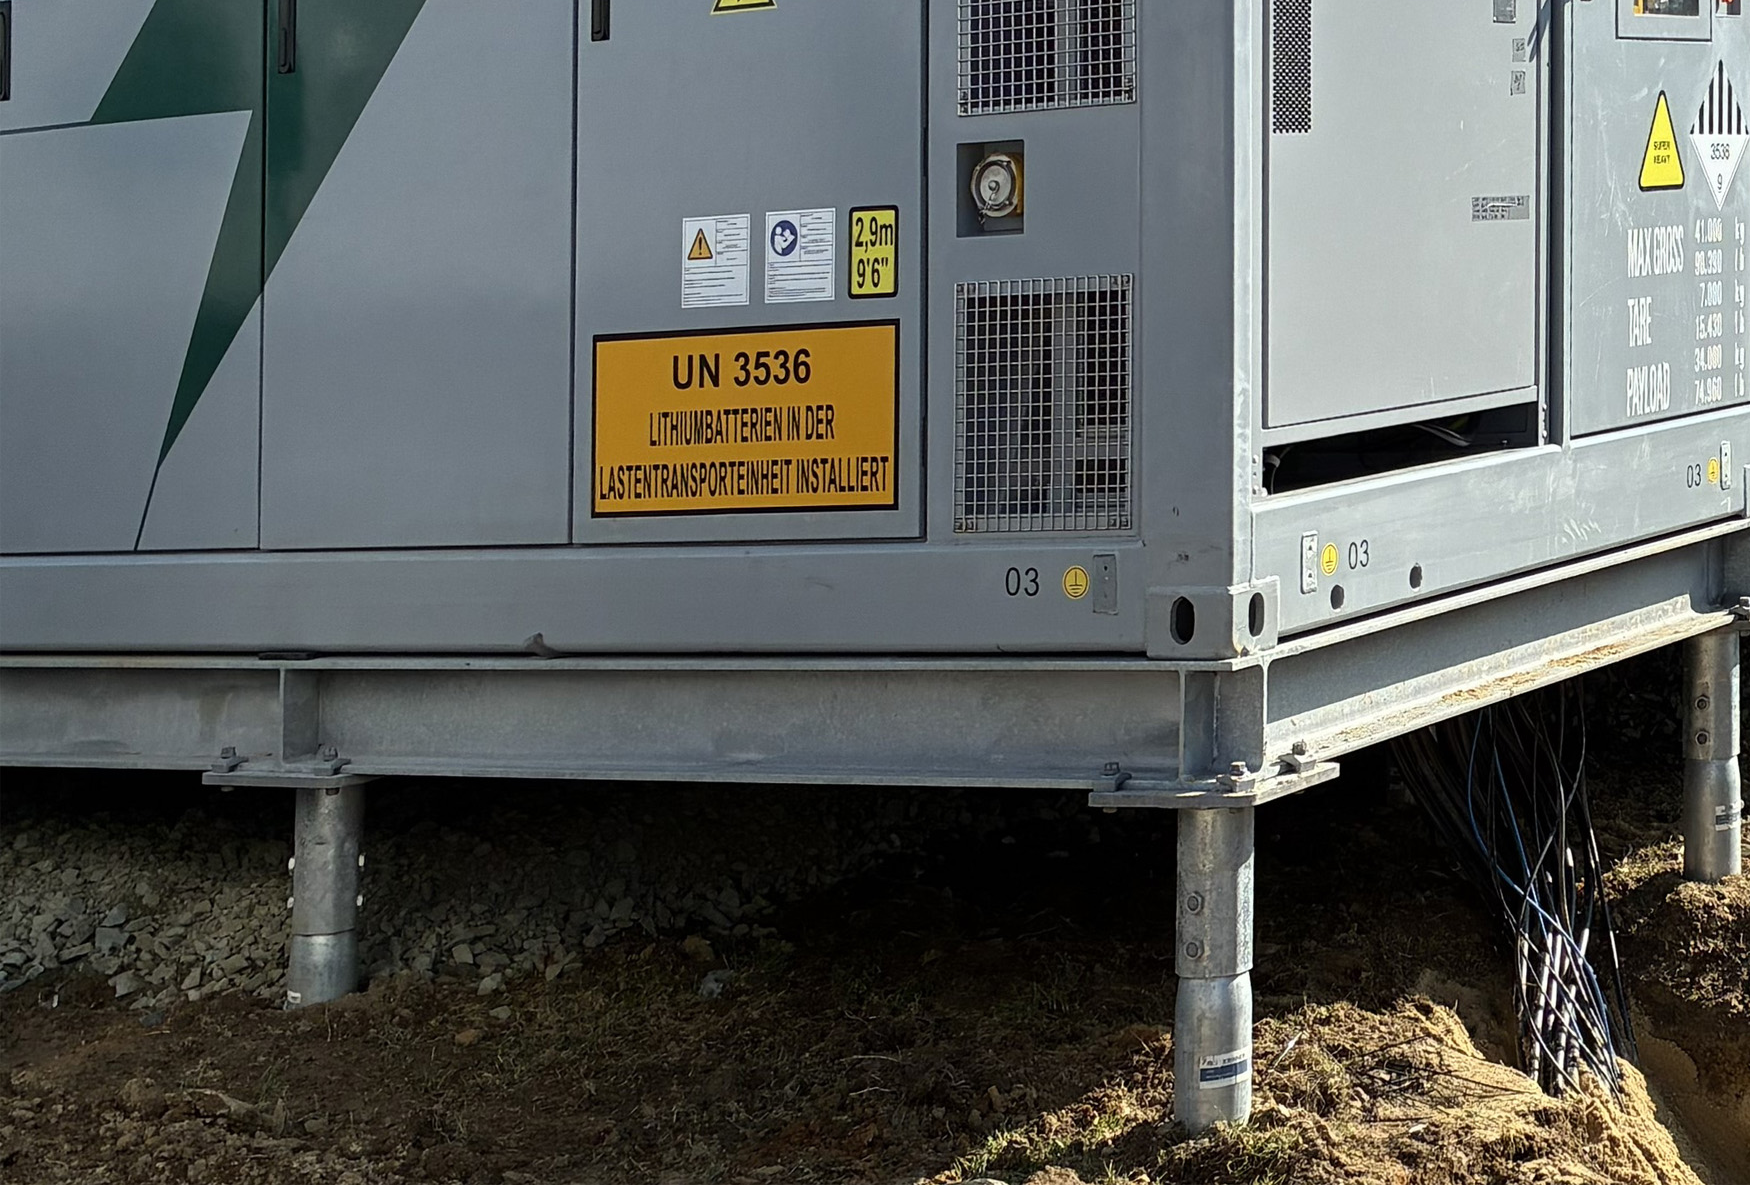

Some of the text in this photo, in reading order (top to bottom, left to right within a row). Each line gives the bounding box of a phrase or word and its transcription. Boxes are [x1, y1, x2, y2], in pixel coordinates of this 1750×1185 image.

[1710, 142, 1731, 161] 3536
[1717, 172, 1723, 191] 9
[855, 215, 894, 254] 2,9m
[1627, 224, 1684, 278] MAX GROSS
[1627, 296, 1652, 347] TARE
[673, 348, 811, 390] UN 3536
[1626, 361, 1671, 418] PAYLOAD
[649, 404, 835, 447] LITHIUMBATTERIEN IN DER
[599, 456, 889, 500] LASTENTRANSPORTEINHEIT INSTALLIERT
[1687, 463, 1702, 488] 03
[1347, 539, 1370, 570] 03
[1004, 566, 1040, 597] 03
